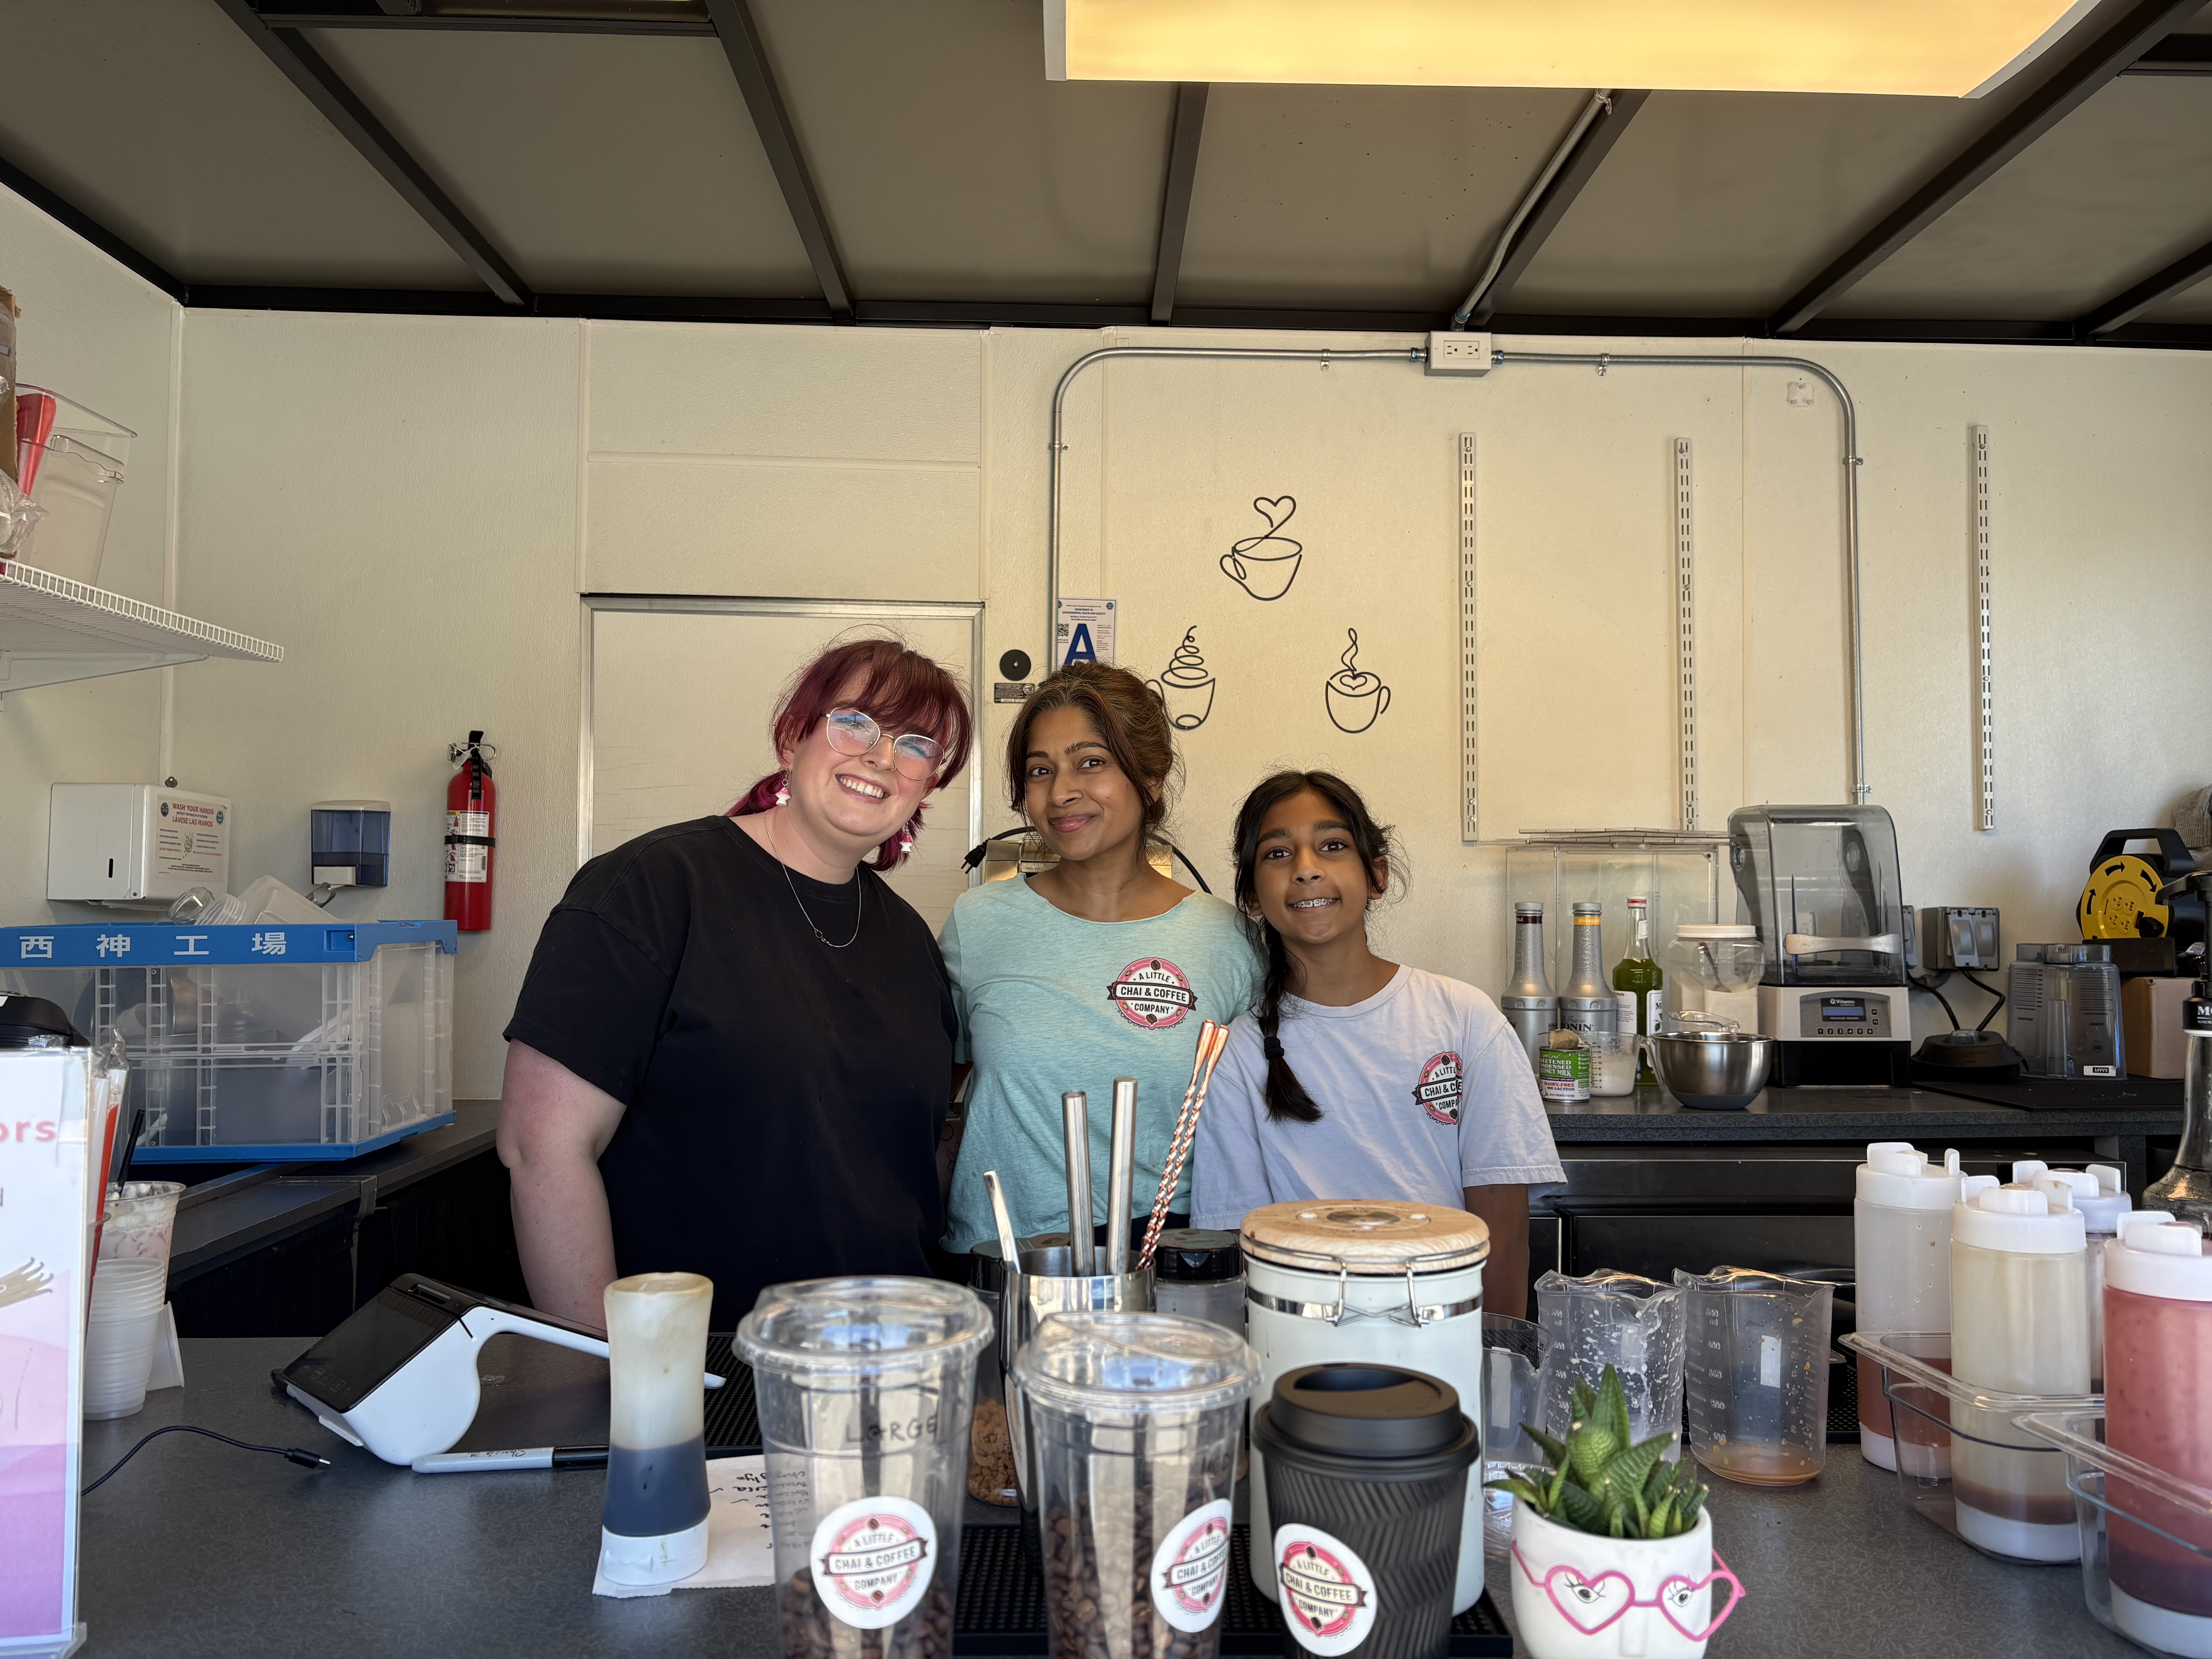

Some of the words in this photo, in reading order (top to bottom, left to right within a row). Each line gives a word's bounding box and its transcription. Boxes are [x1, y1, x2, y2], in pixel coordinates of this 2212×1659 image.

[1064, 623, 1097, 665] A
[19, 932, 287, 959] 西神工場
[1146, 972, 1171, 982] LITTLE
[1121, 987, 1142, 996] CHAI
[1145, 988, 1151, 996] &
[1154, 989, 1186, 1002] COFFEE
[1134, 1003, 1170, 1014] COMPANY
[1439, 1066, 1456, 1075] LITTL
[1425, 1085, 1441, 1097] CHAI
[1443, 1084, 1449, 1093] &
[854, 1539, 861, 1548] A
[862, 1534, 894, 1545] LITTLE
[1202, 1536, 1220, 1550] LITTLE
[835, 1559, 861, 1570] CHAI
[865, 1558, 873, 1568] &
[876, 1546, 915, 1566] COFFEE
[1177, 1566, 1198, 1581] CHAI
[1200, 1562, 1206, 1572] &
[1297, 1560, 1302, 1568] A
[1303, 1561, 1330, 1576] LITTLE
[854, 1573, 897, 1590] COMPANY
[1192, 1575, 1218, 1596] COMPANY
[1286, 1572, 1302, 1590] CHAI
[1305, 1582, 1312, 1593] &
[1314, 1584, 1353, 1601] COFFEE
[1298, 1599, 1334, 1618] COMPANY
